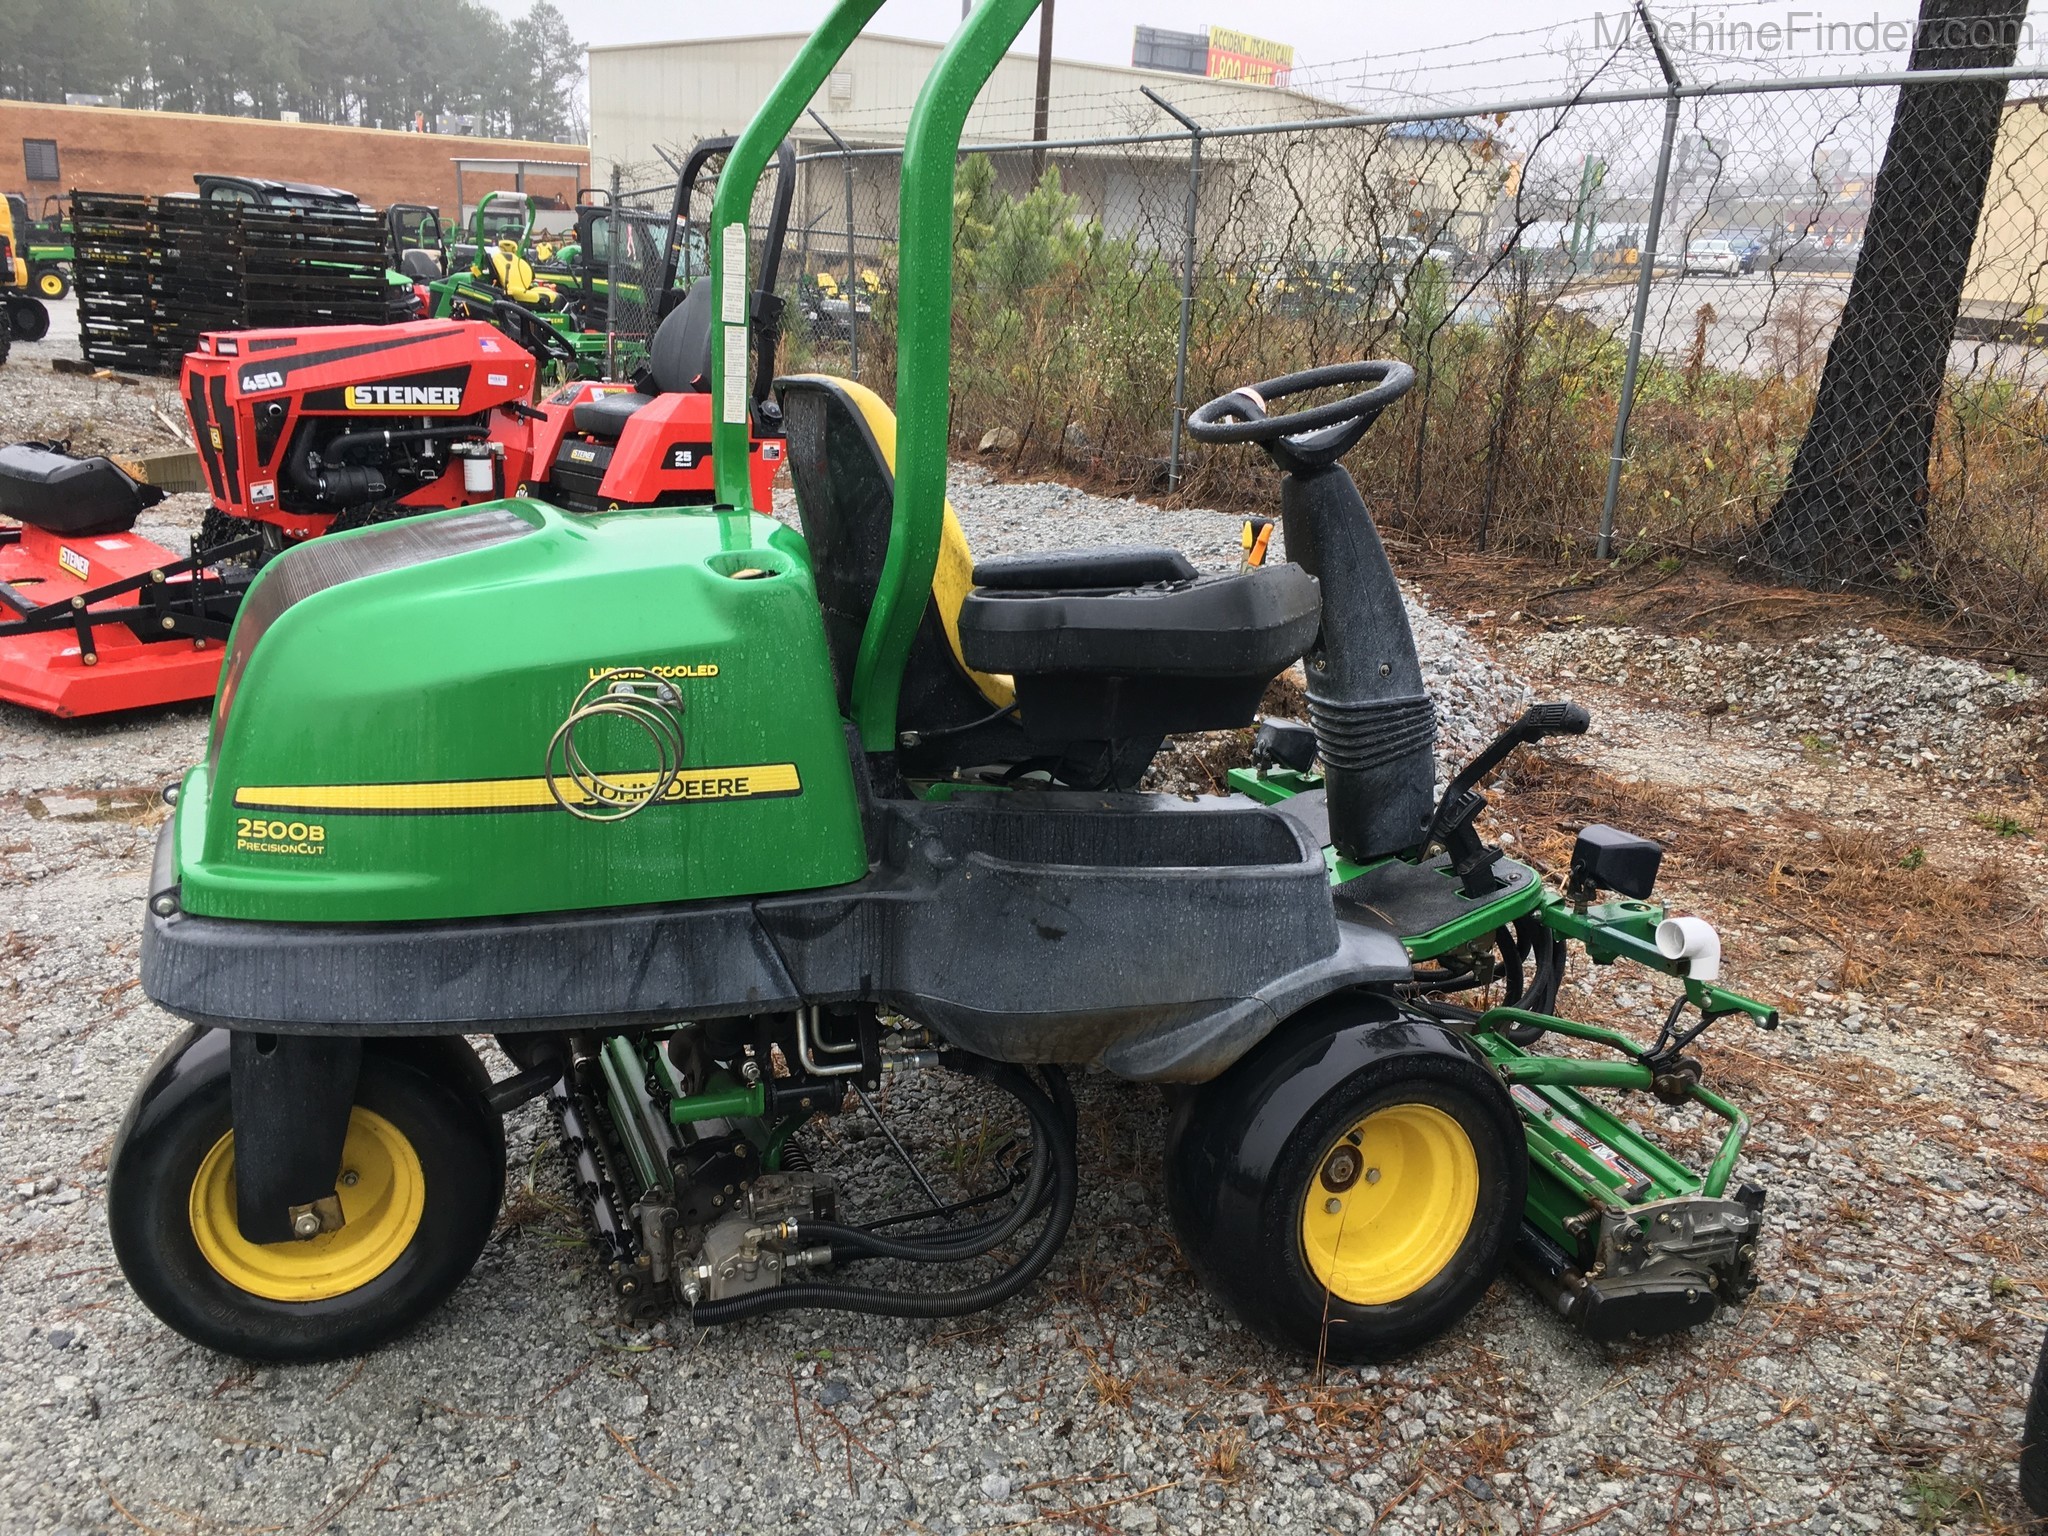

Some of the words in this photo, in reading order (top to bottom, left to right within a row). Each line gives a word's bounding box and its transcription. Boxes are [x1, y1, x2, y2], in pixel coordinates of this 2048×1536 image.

[242, 371, 284, 391] 450
[355, 385, 461, 405] STEINER
[675, 451, 692, 462] 25
[61, 546, 90, 576] STEINER
[652, 665, 719, 677] COOLED
[664, 777, 749, 800] DEERE
[237, 818, 325, 841] 2500B
